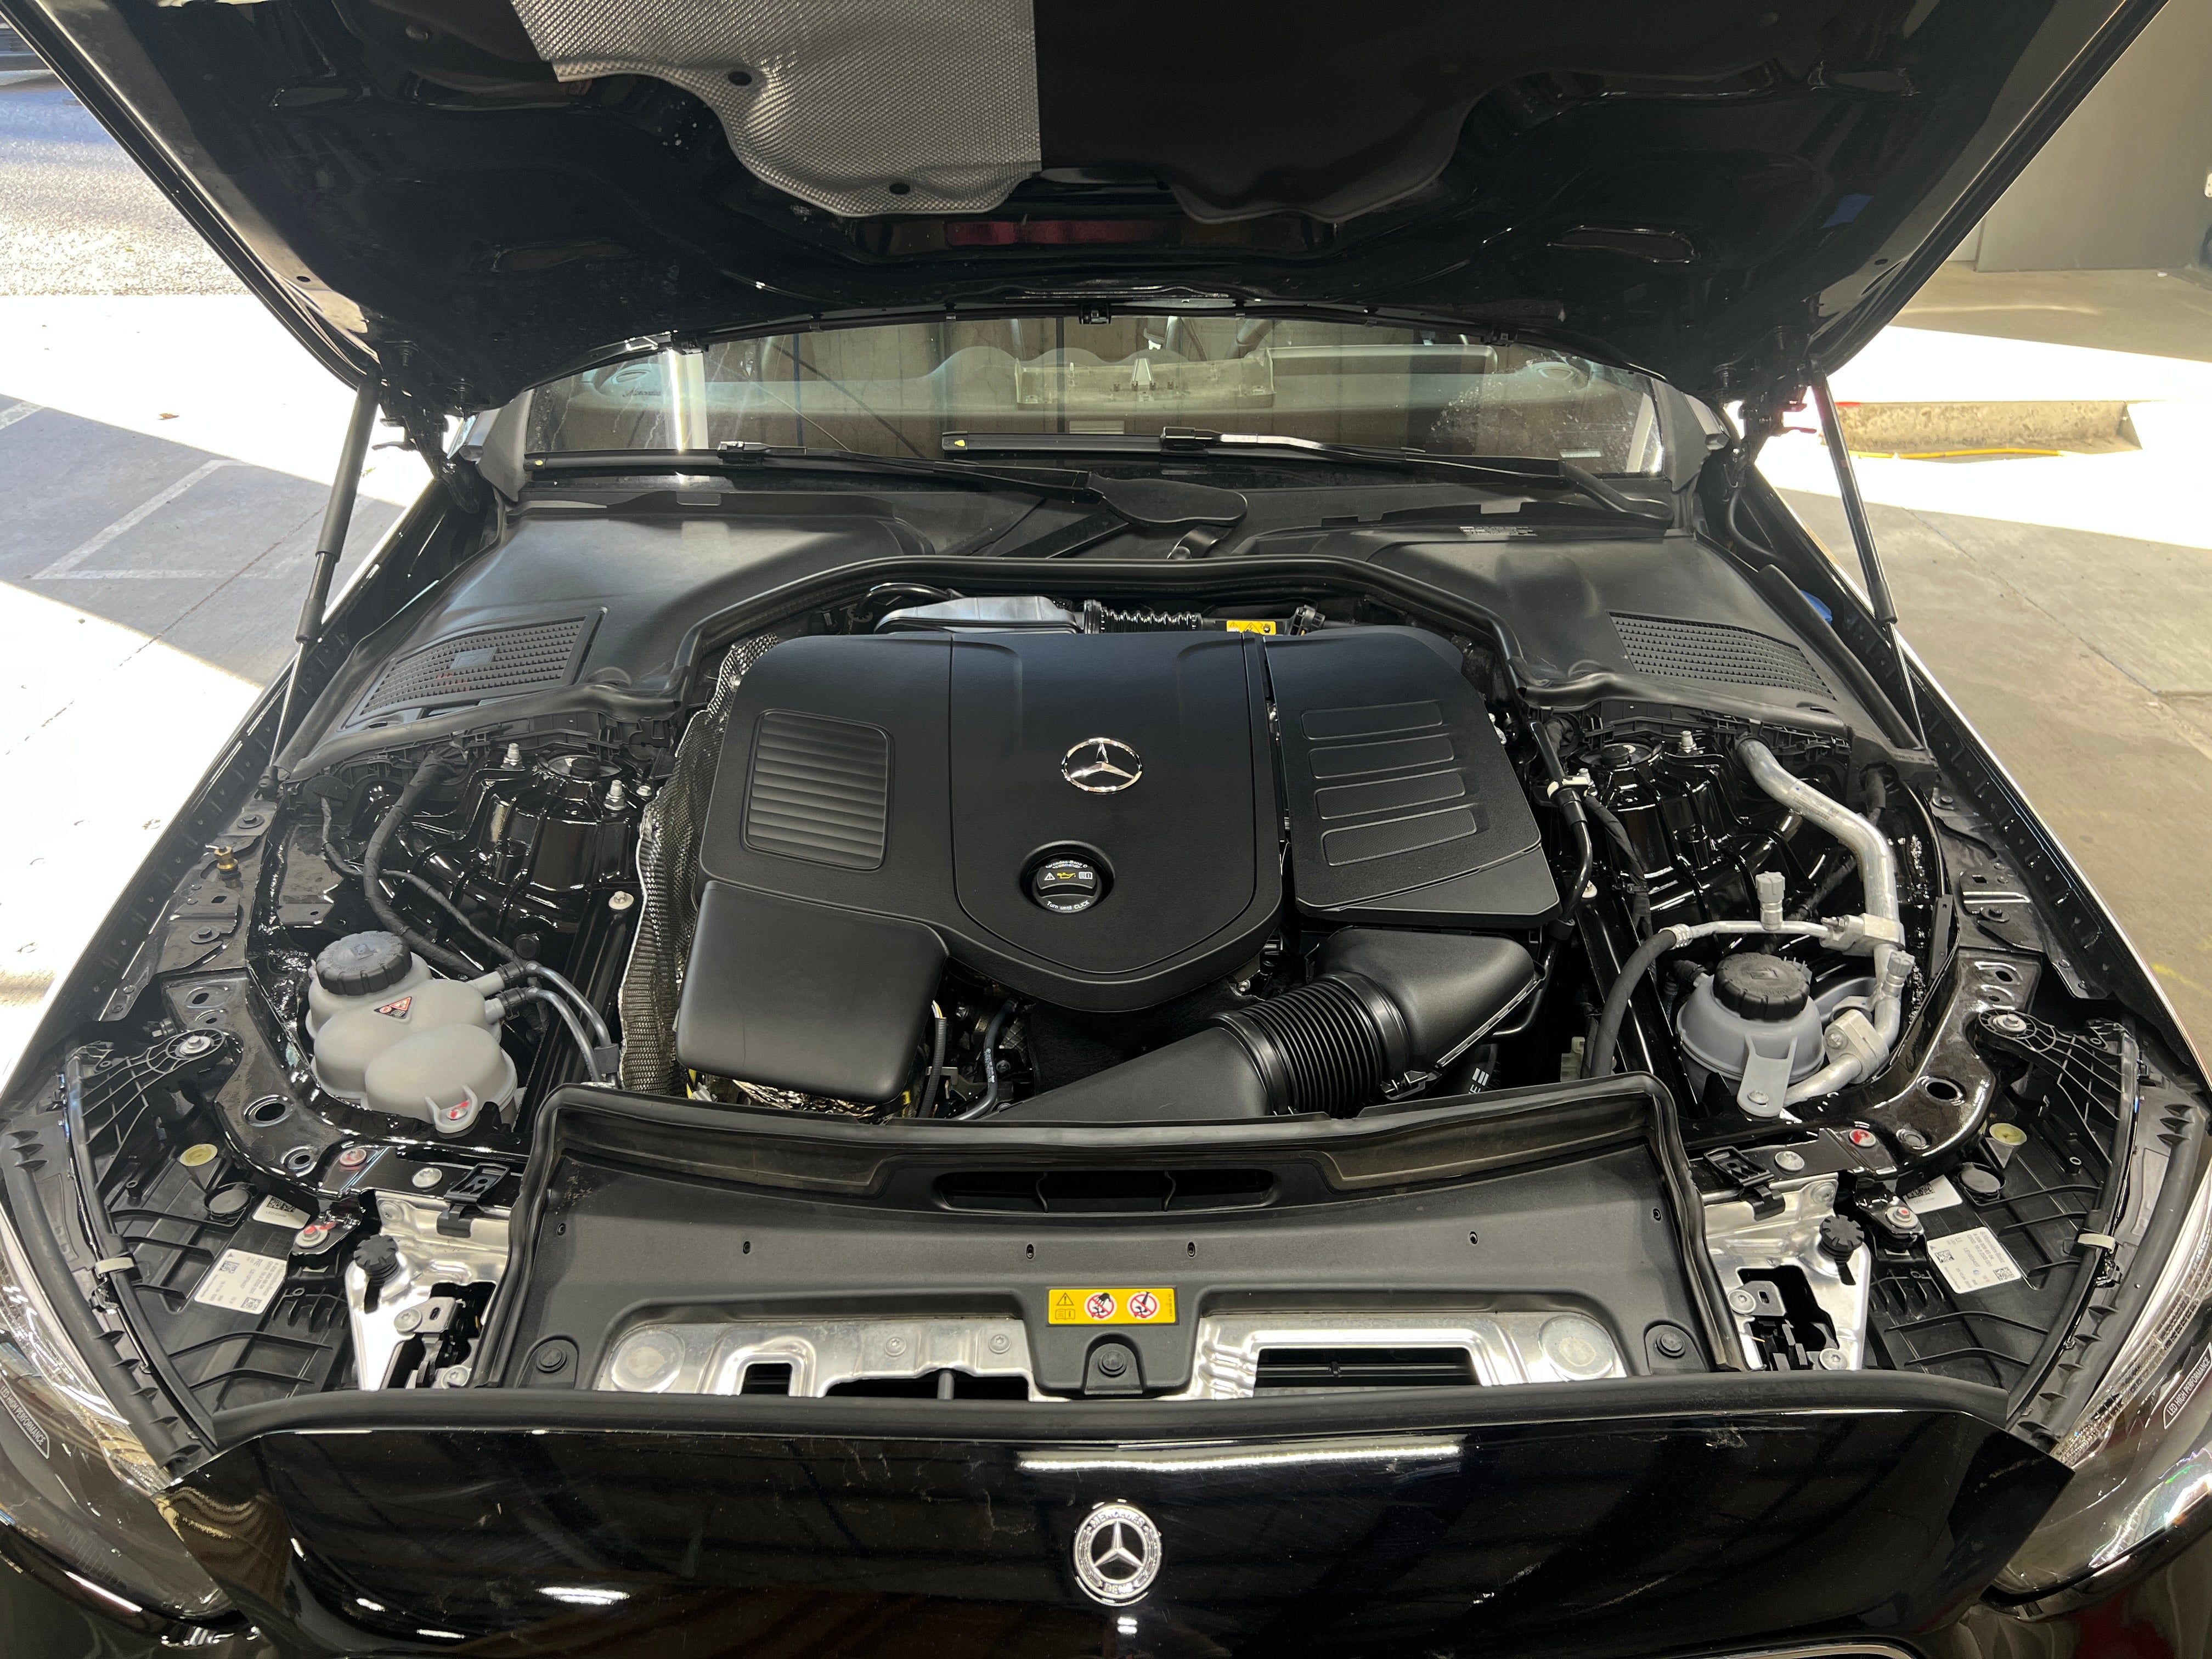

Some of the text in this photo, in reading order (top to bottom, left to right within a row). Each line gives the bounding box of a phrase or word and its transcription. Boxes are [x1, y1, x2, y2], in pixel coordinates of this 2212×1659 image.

[1047, 901, 1059, 910] Turn
[1074, 900, 1090, 910] CLICK
[0, 1385, 46, 1446] LED HIGH PERFORMANCE
[2166, 1356, 2210, 1416] LED HIGH PERFORMANCE
